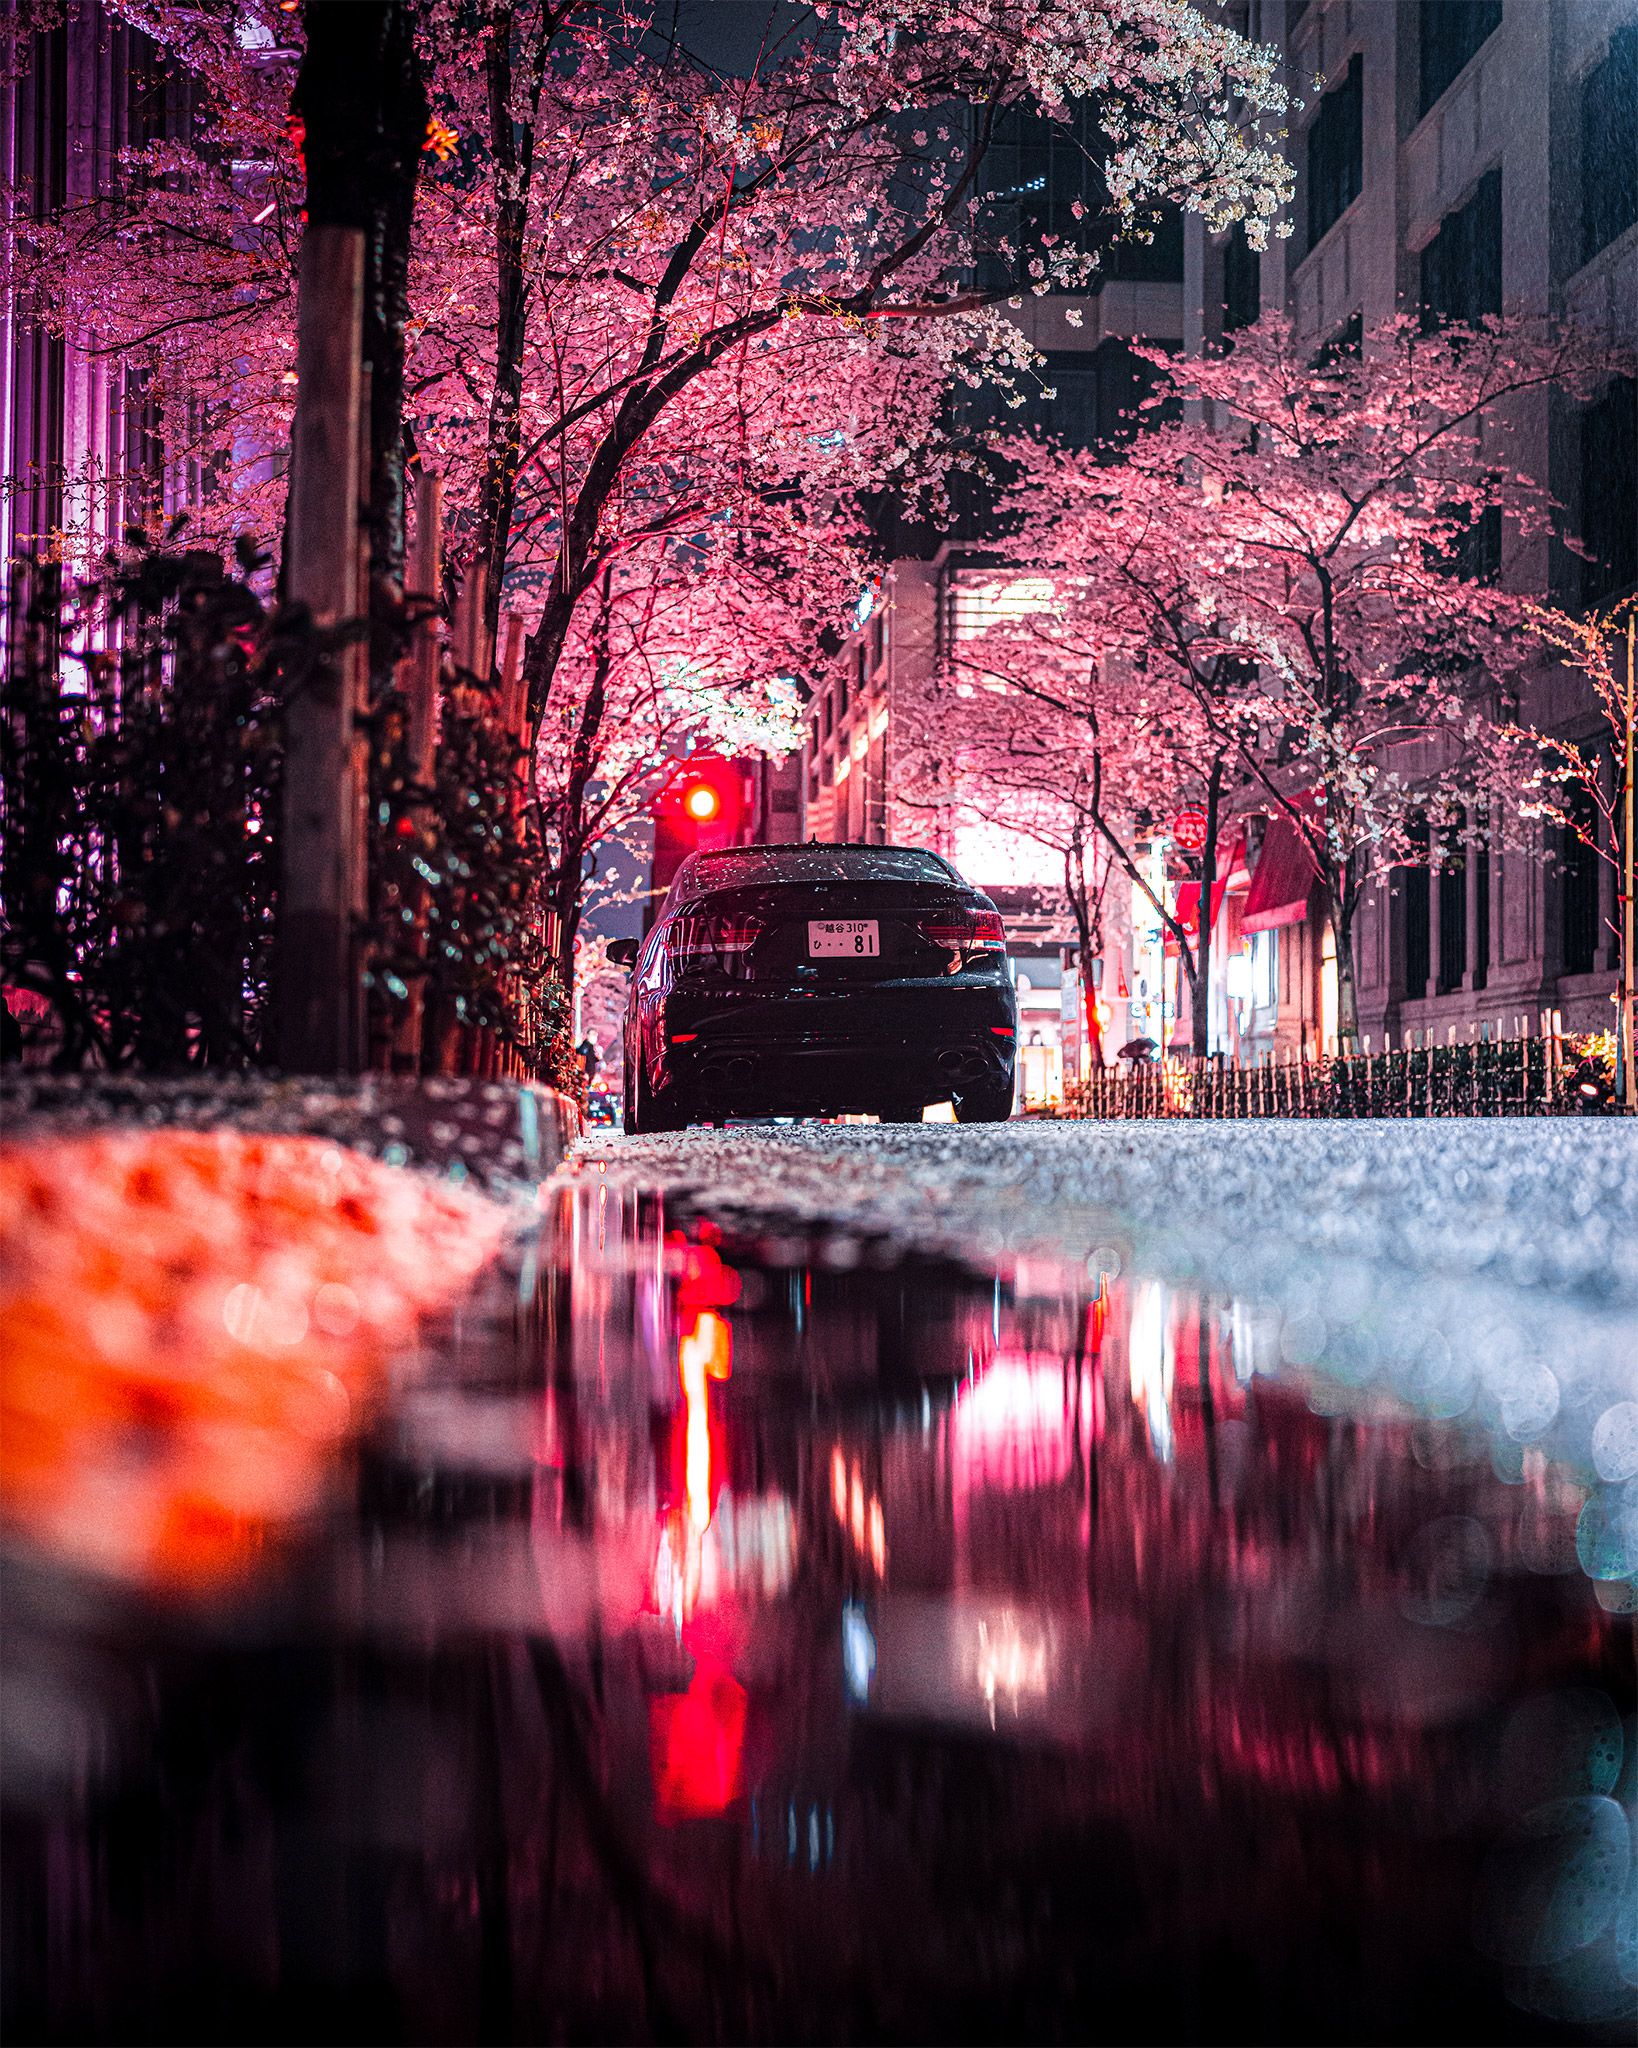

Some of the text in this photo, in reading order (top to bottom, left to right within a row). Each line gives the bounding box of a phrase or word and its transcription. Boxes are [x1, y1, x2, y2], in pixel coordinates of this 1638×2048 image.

[825, 923, 864, 933] 越谷 310
[814, 935, 873, 953] ひ 81
